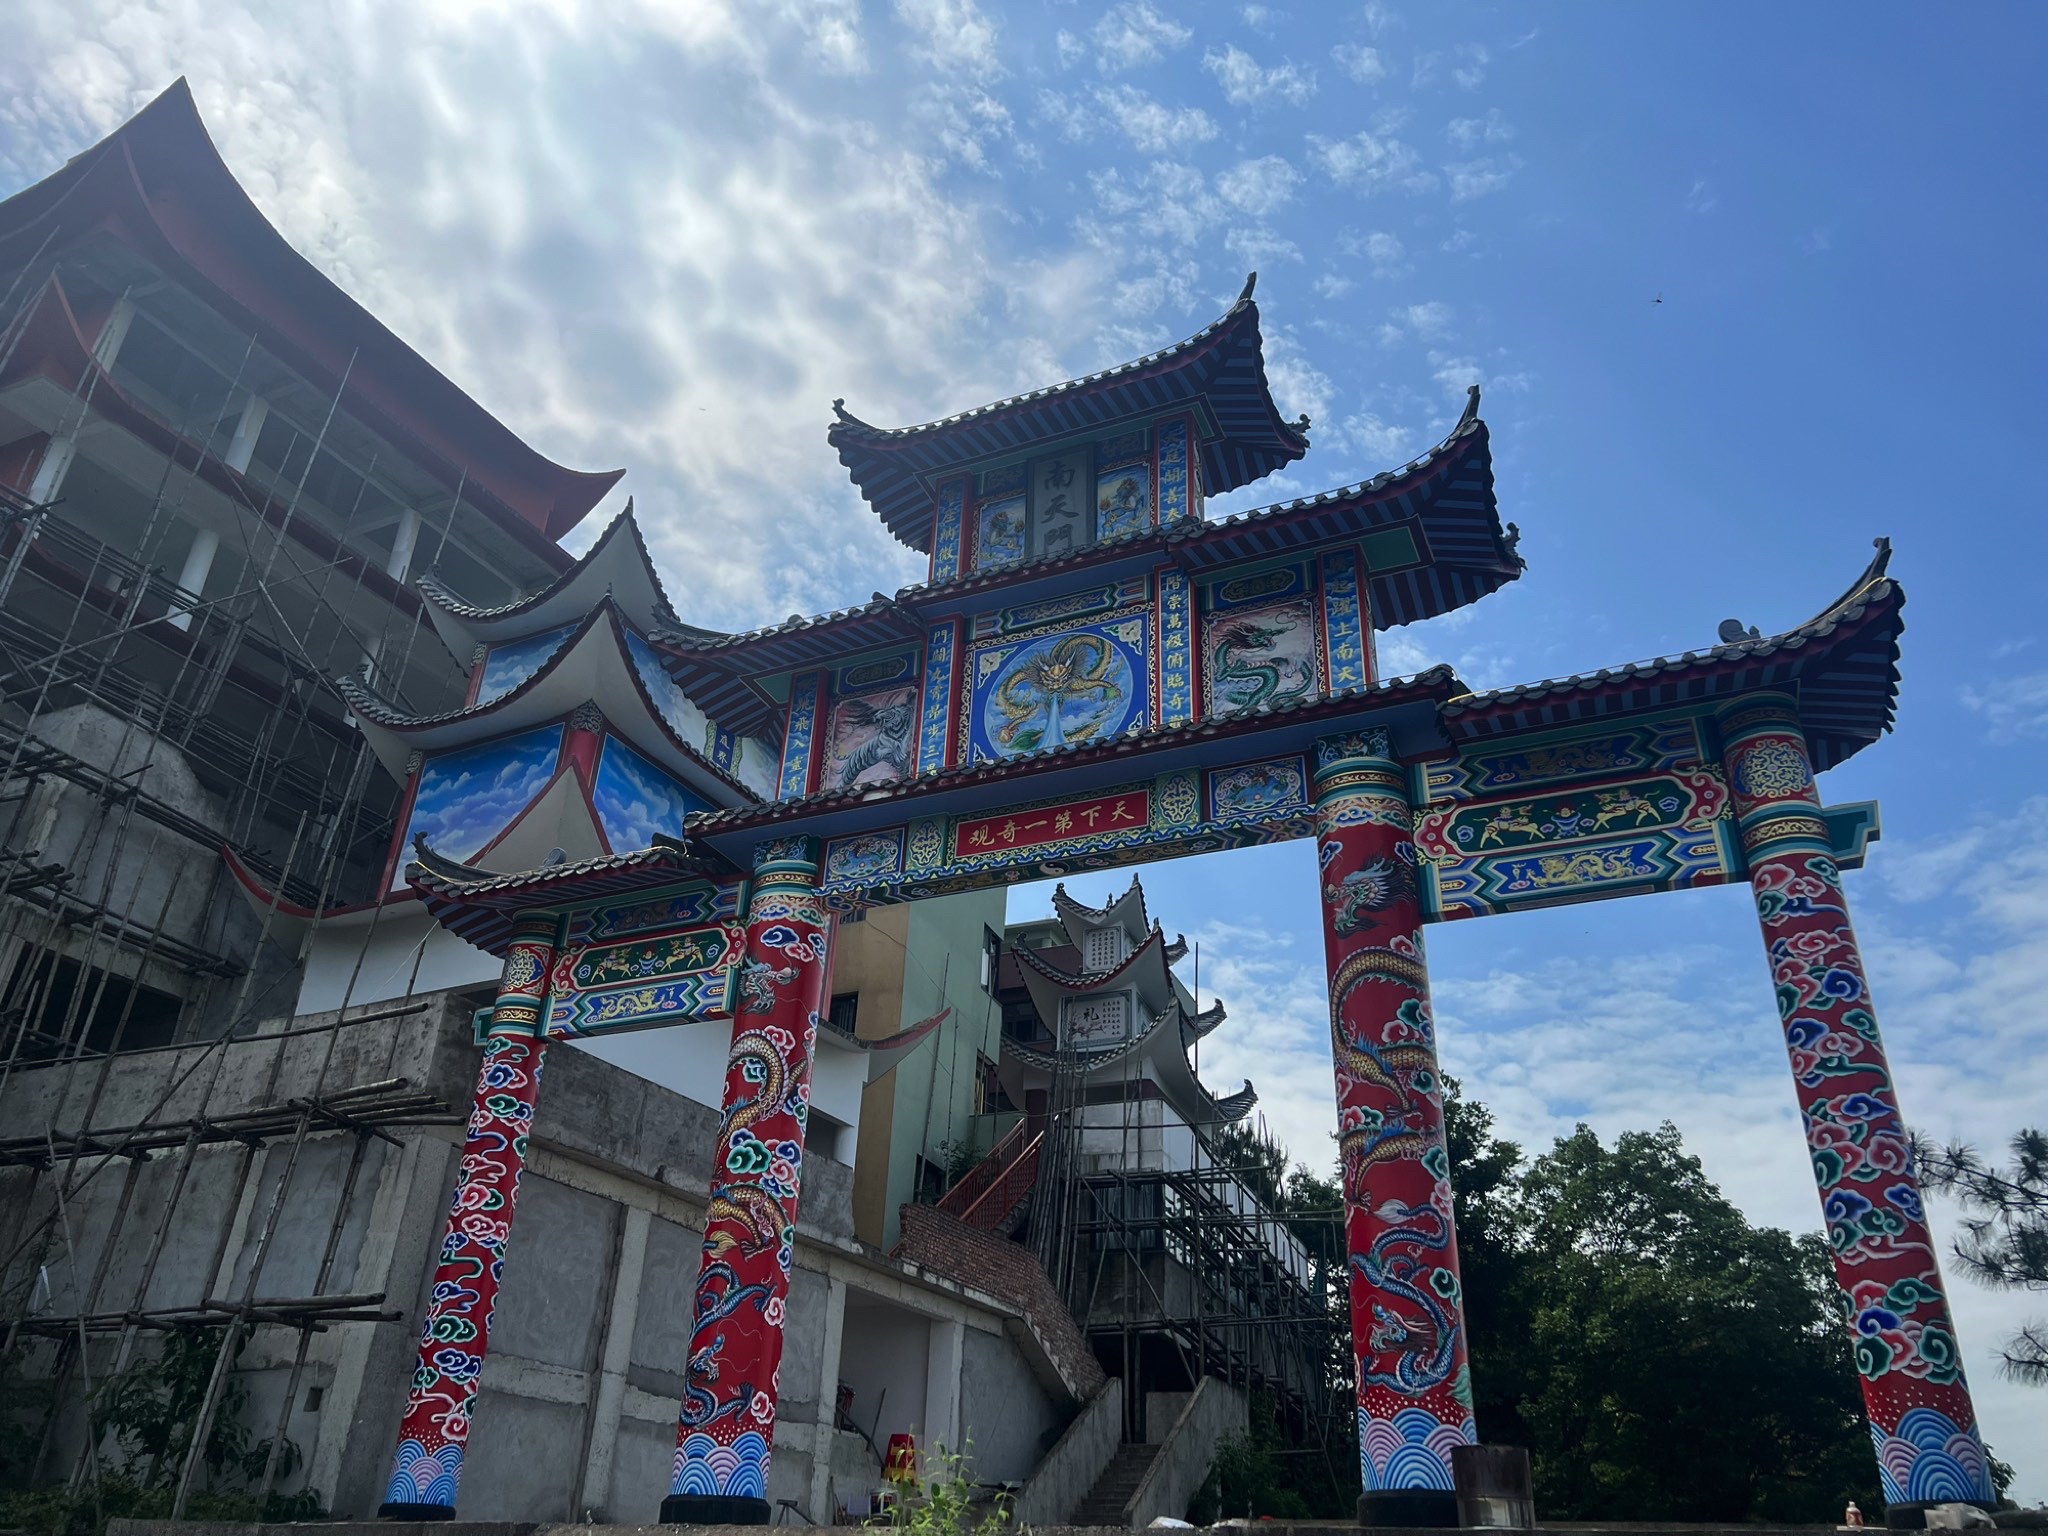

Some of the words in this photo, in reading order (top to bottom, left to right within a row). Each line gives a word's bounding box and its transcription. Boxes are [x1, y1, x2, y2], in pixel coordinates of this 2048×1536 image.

[1043, 461, 1079, 552] 南天門
[969, 801, 1135, 846] 天下第一奇观
[1083, 1006, 1100, 1022] 礼
